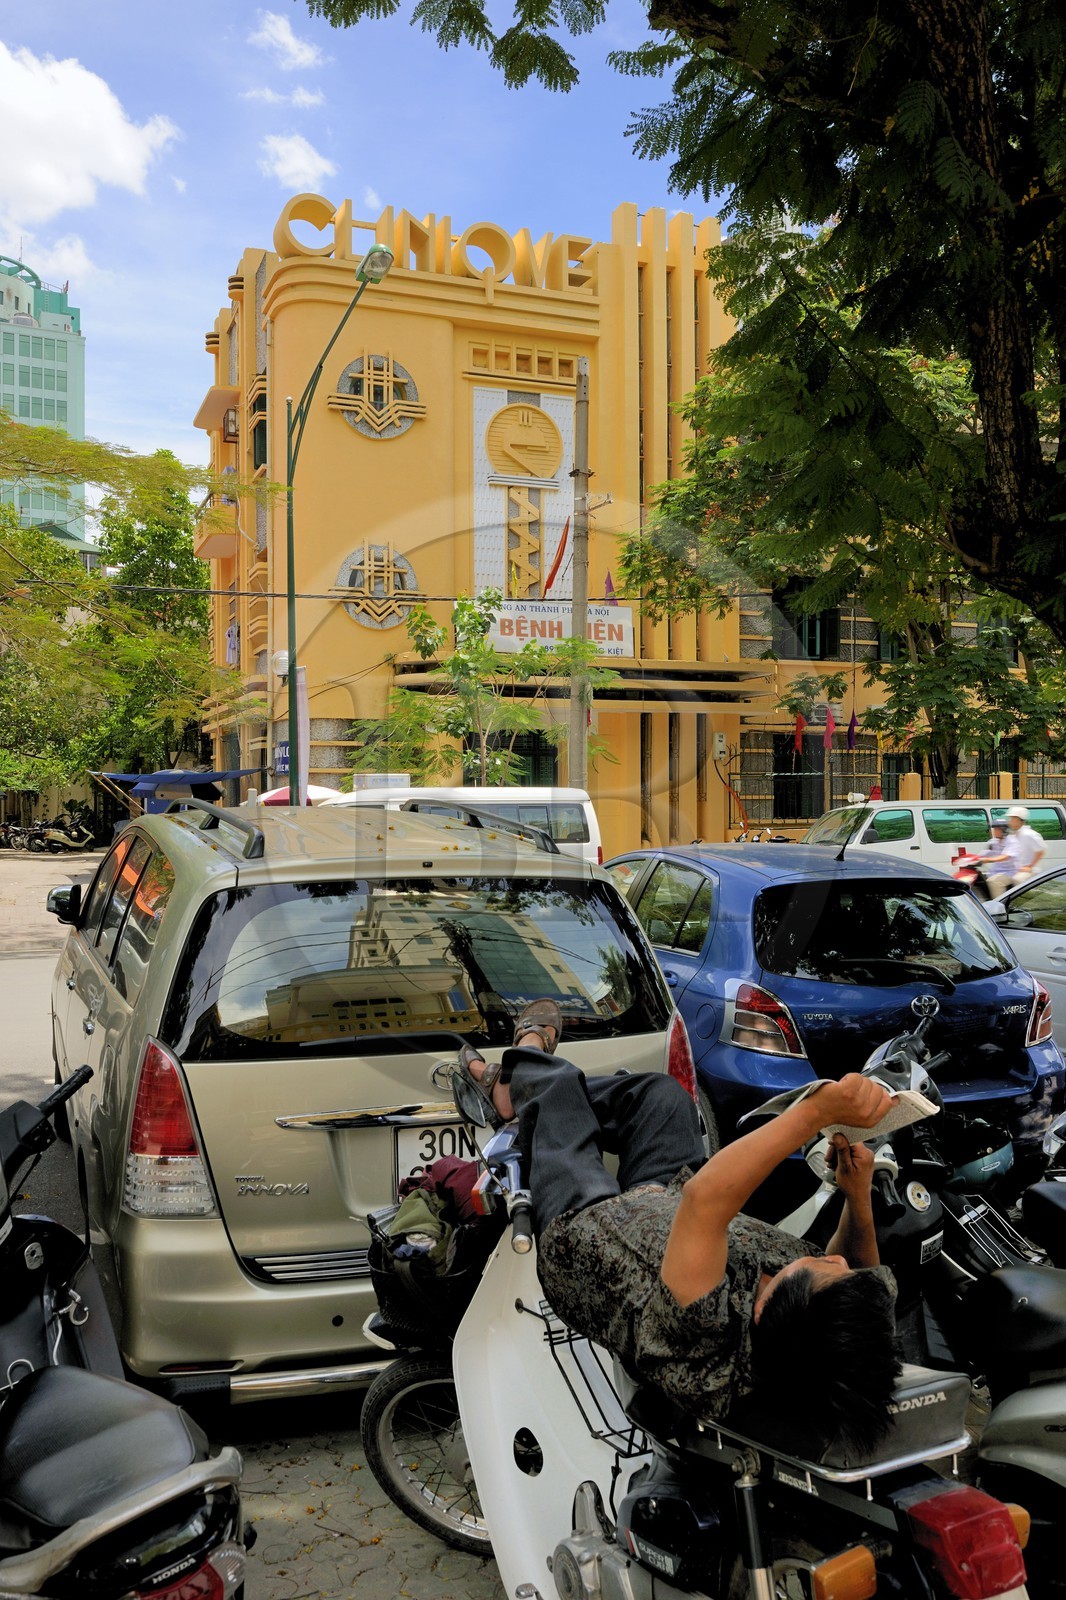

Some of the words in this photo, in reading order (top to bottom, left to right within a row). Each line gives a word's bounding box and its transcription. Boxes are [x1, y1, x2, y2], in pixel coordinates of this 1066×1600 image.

[529, 604, 559, 613] THÀNH
[500, 615, 563, 641] BỆNH
[587, 619, 624, 644] IỆN
[608, 647, 624, 656] KIỆT
[802, 1013, 834, 1021] TOYOTA
[419, 1126, 476, 1161] 30N
[238, 1183, 309, 1196] INNOVA
[152, 1558, 196, 1584] HONDA
